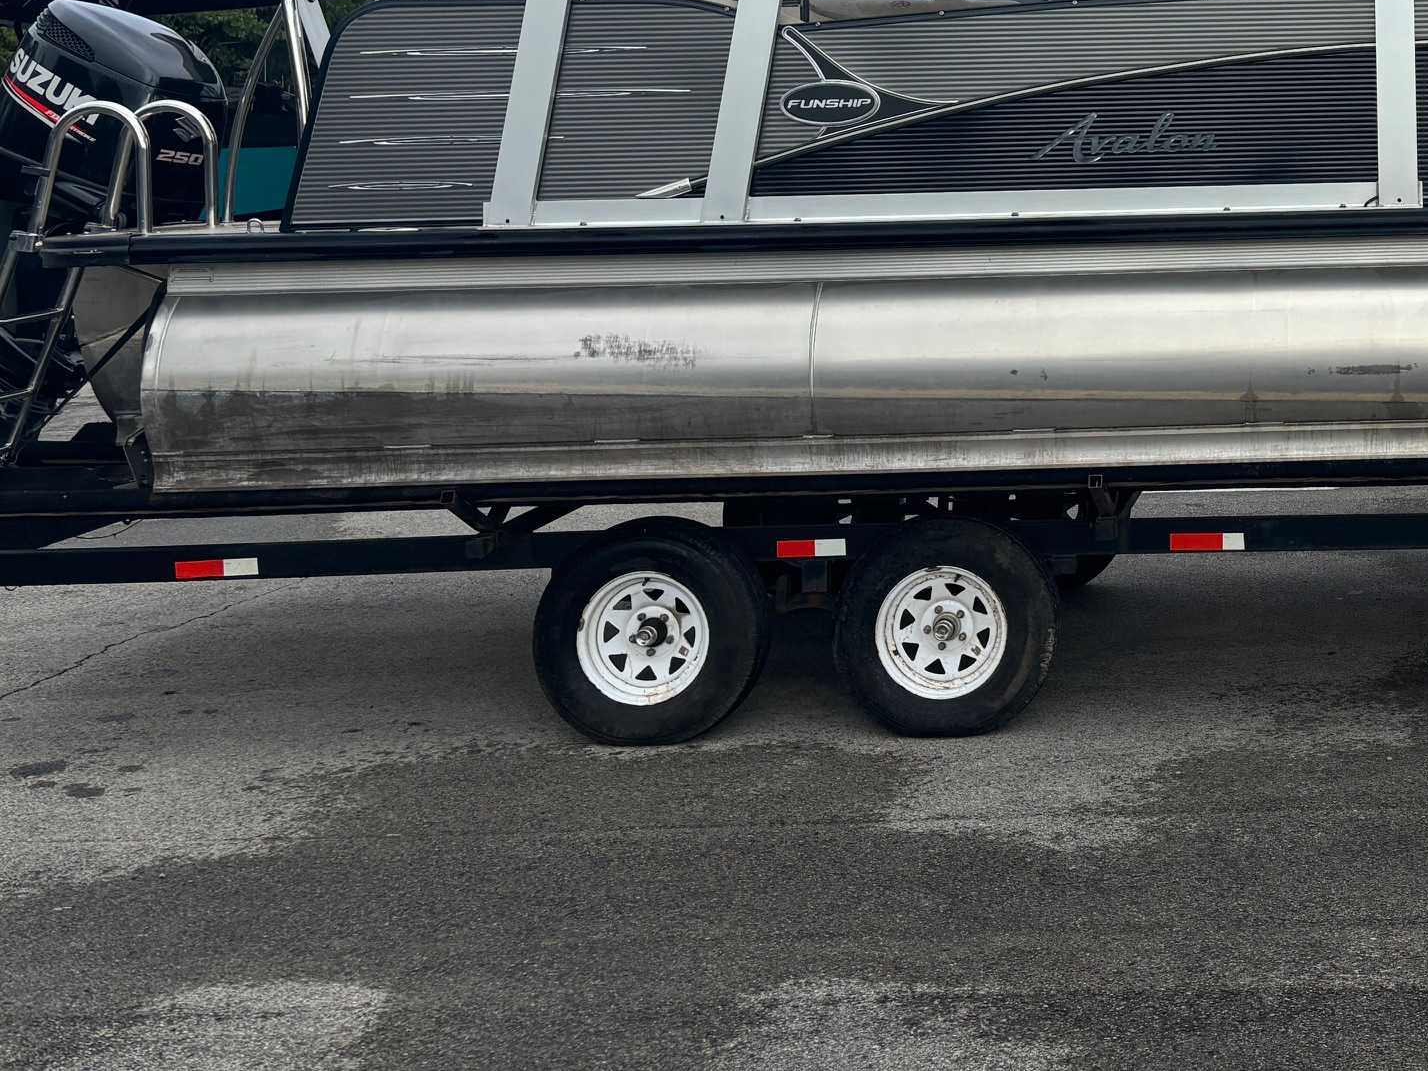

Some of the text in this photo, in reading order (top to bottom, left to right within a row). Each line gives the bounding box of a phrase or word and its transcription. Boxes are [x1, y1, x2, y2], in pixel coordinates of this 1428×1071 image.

[787, 98, 872, 109] FUNSHIP
[1027, 112, 1217, 163] Avalon
[156, 148, 204, 166] 250
